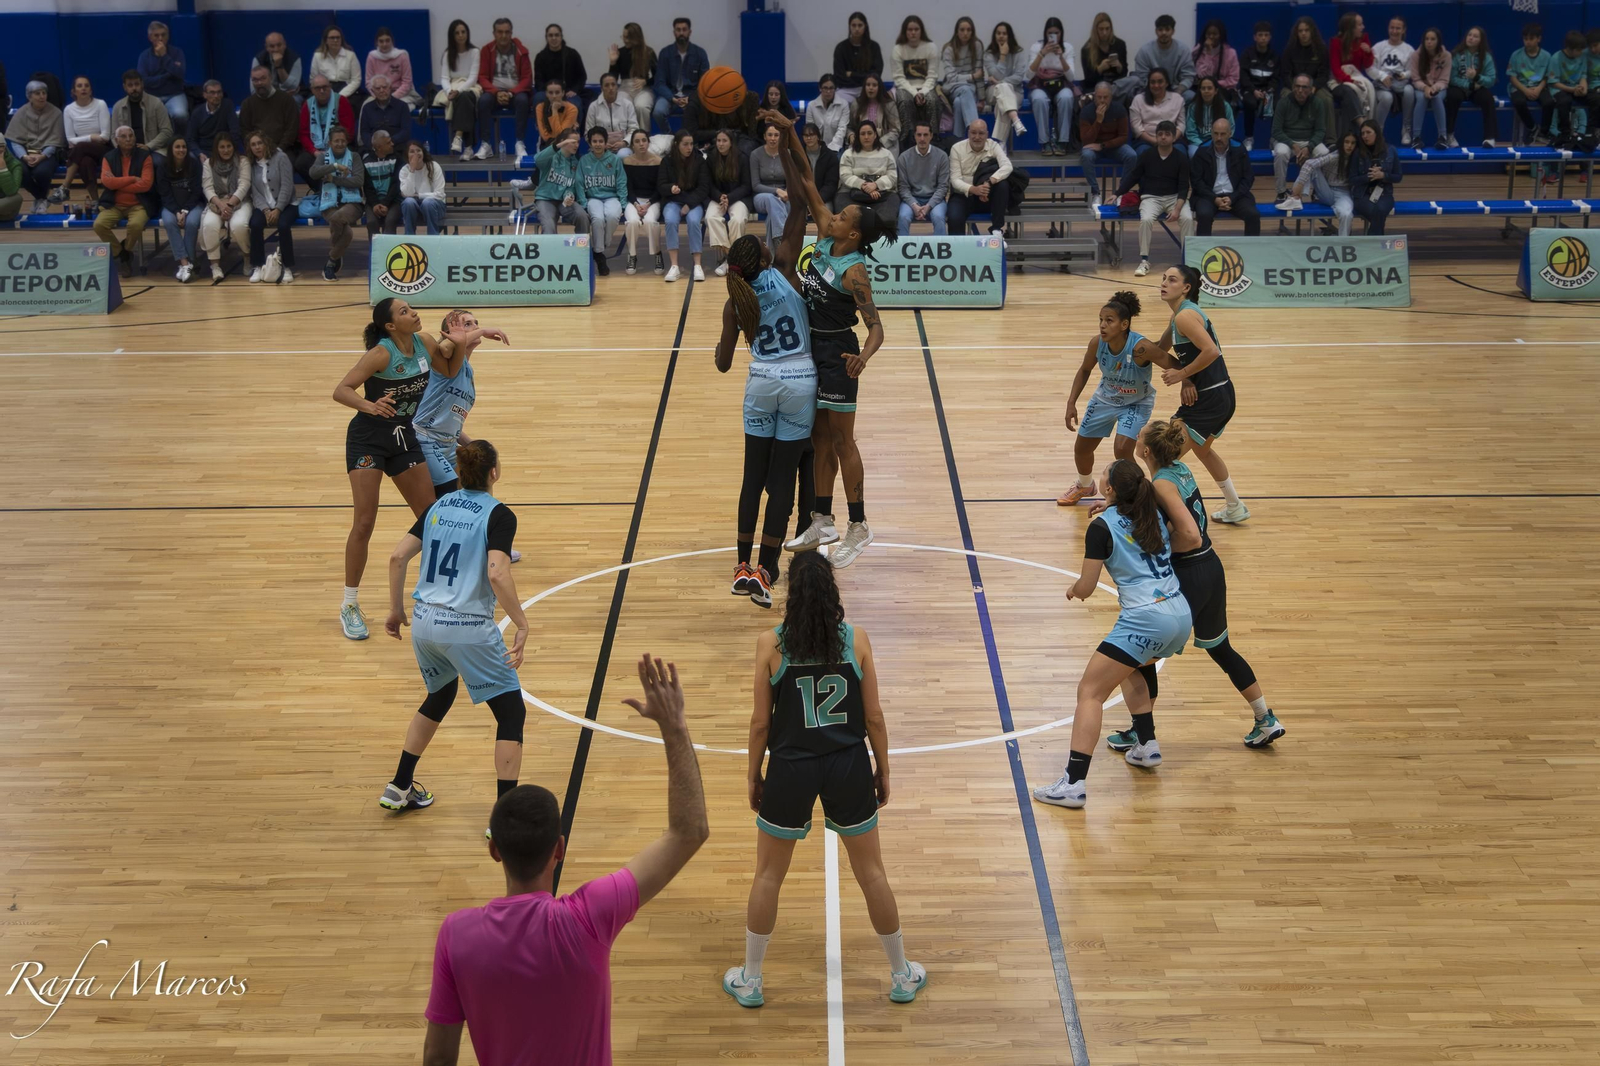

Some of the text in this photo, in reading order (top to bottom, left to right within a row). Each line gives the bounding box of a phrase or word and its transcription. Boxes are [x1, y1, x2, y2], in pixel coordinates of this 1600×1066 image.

[546, 167, 577, 188] ESTEPON
[584, 173, 616, 189] ESTEPONA
[489, 243, 540, 260] CAB
[901, 242, 953, 260] CAB
[1305, 245, 1358, 263] CAB
[7, 252, 59, 270] CAB
[447, 264, 583, 283] ESTEPONA
[1263, 267, 1403, 286] ESTEPONA
[1542, 268, 1595, 287] ESTEPONA
[381, 275, 433, 293] ESTEPONA
[456, 288, 575, 296] www.baloncestoestepona.com
[760, 295, 786, 312] avent
[1274, 290, 1395, 299] www.baloncestoestepona.com
[758, 314, 801, 356] 28
[780, 373, 804, 381] guanyam
[396, 401, 418, 417] 24
[438, 514, 475, 531] bravent
[425, 538, 462, 587] 14
[1139, 546, 1173, 580] 15
[434, 618, 460, 627] guanyam
[1127, 633, 1164, 655] egea
[795, 674, 848, 729] 12
